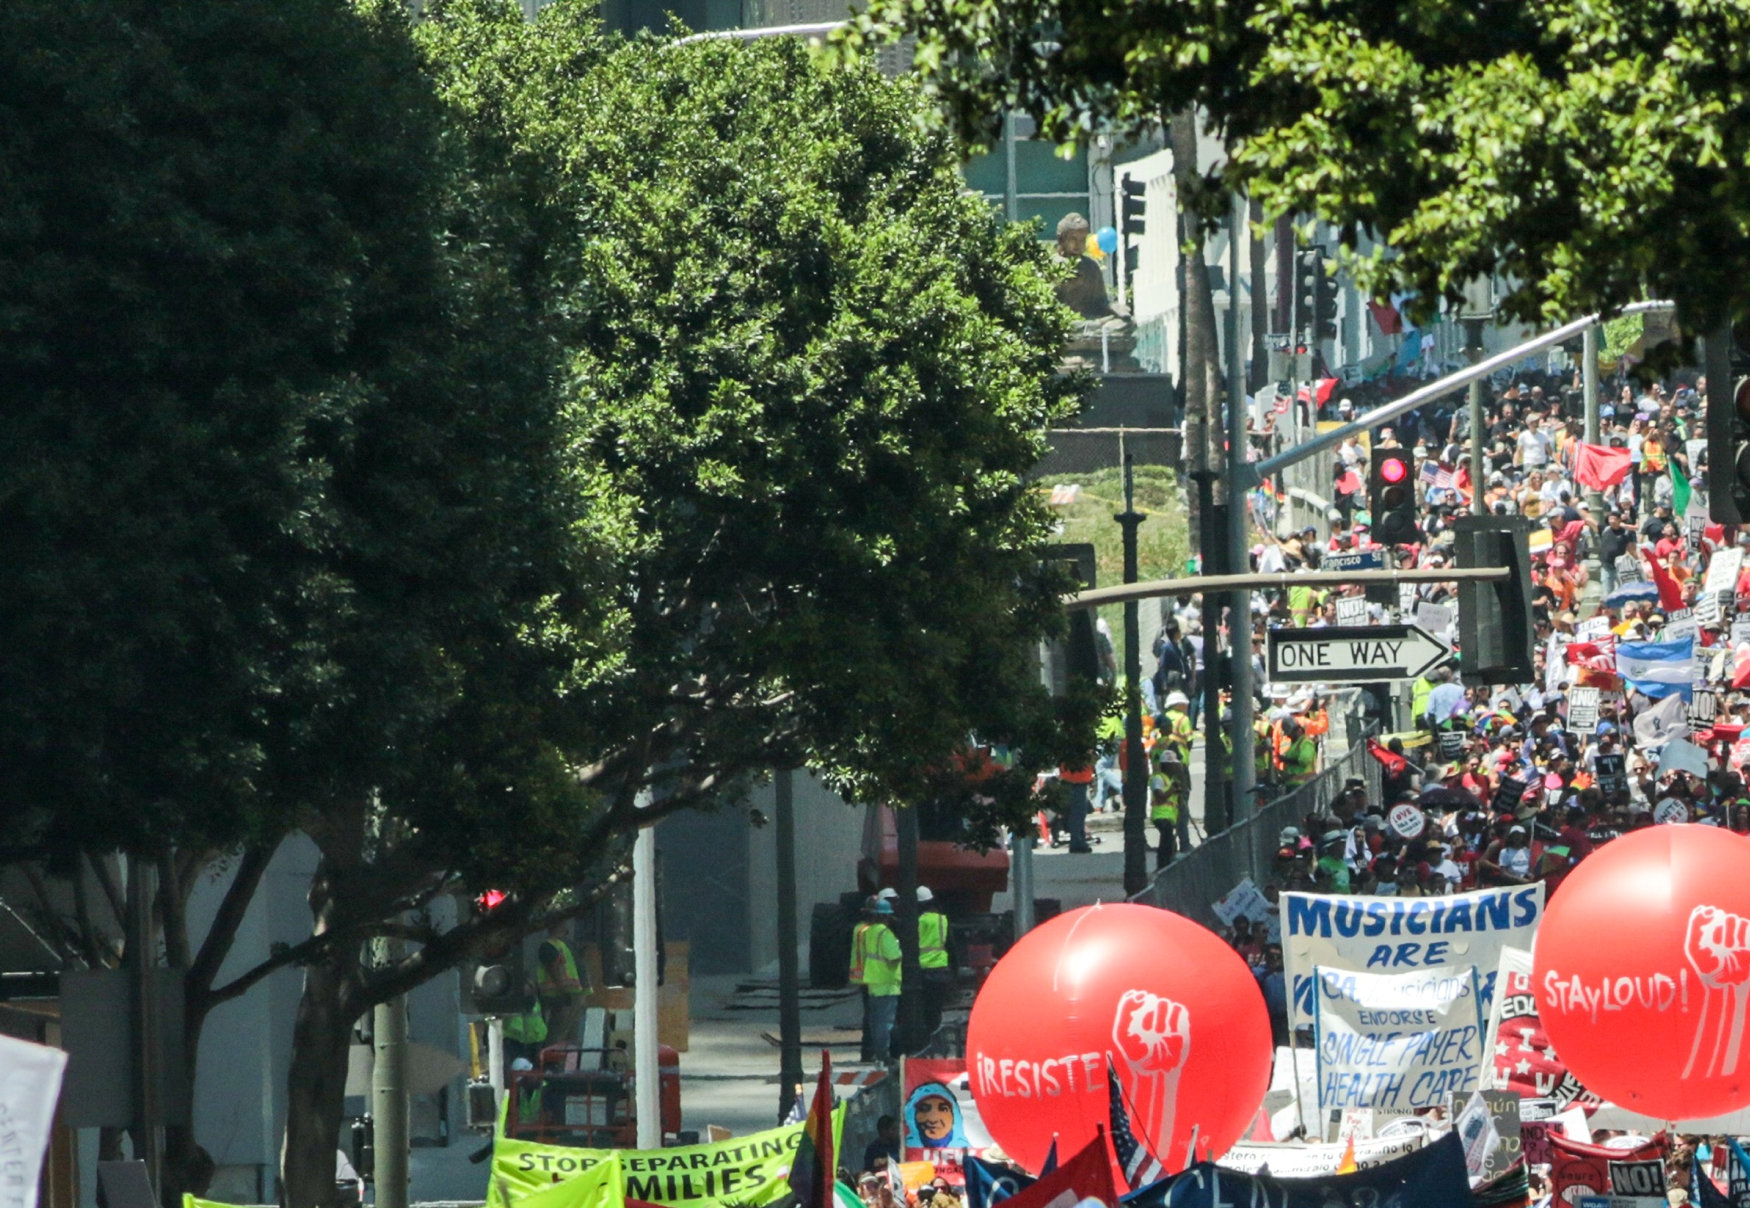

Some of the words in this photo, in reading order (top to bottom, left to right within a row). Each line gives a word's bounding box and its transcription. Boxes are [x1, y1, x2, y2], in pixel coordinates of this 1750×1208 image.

[1321, 556, 1361, 570] Francisco
[1372, 552, 1382, 562] St
[1340, 599, 1365, 619] NO!
[1281, 643, 1331, 667] ONE
[1350, 641, 1403, 665] WAY
[1287, 888, 1538, 938] MUSICIANS
[1367, 941, 1450, 968] ARE
[1603, 968, 1689, 1013] LOUD!
[1357, 1010, 1437, 1026] ENDORSE
[1322, 1031, 1402, 1067] SINGLE
[1398, 1025, 1478, 1067] PAYER
[1320, 1070, 1404, 1109] HEALTH
[518, 1152, 601, 1173] STOP
[620, 1131, 804, 1173] SEPARATING
[626, 1164, 767, 1202] MILIES
[1612, 1163, 1663, 1194] NO!
